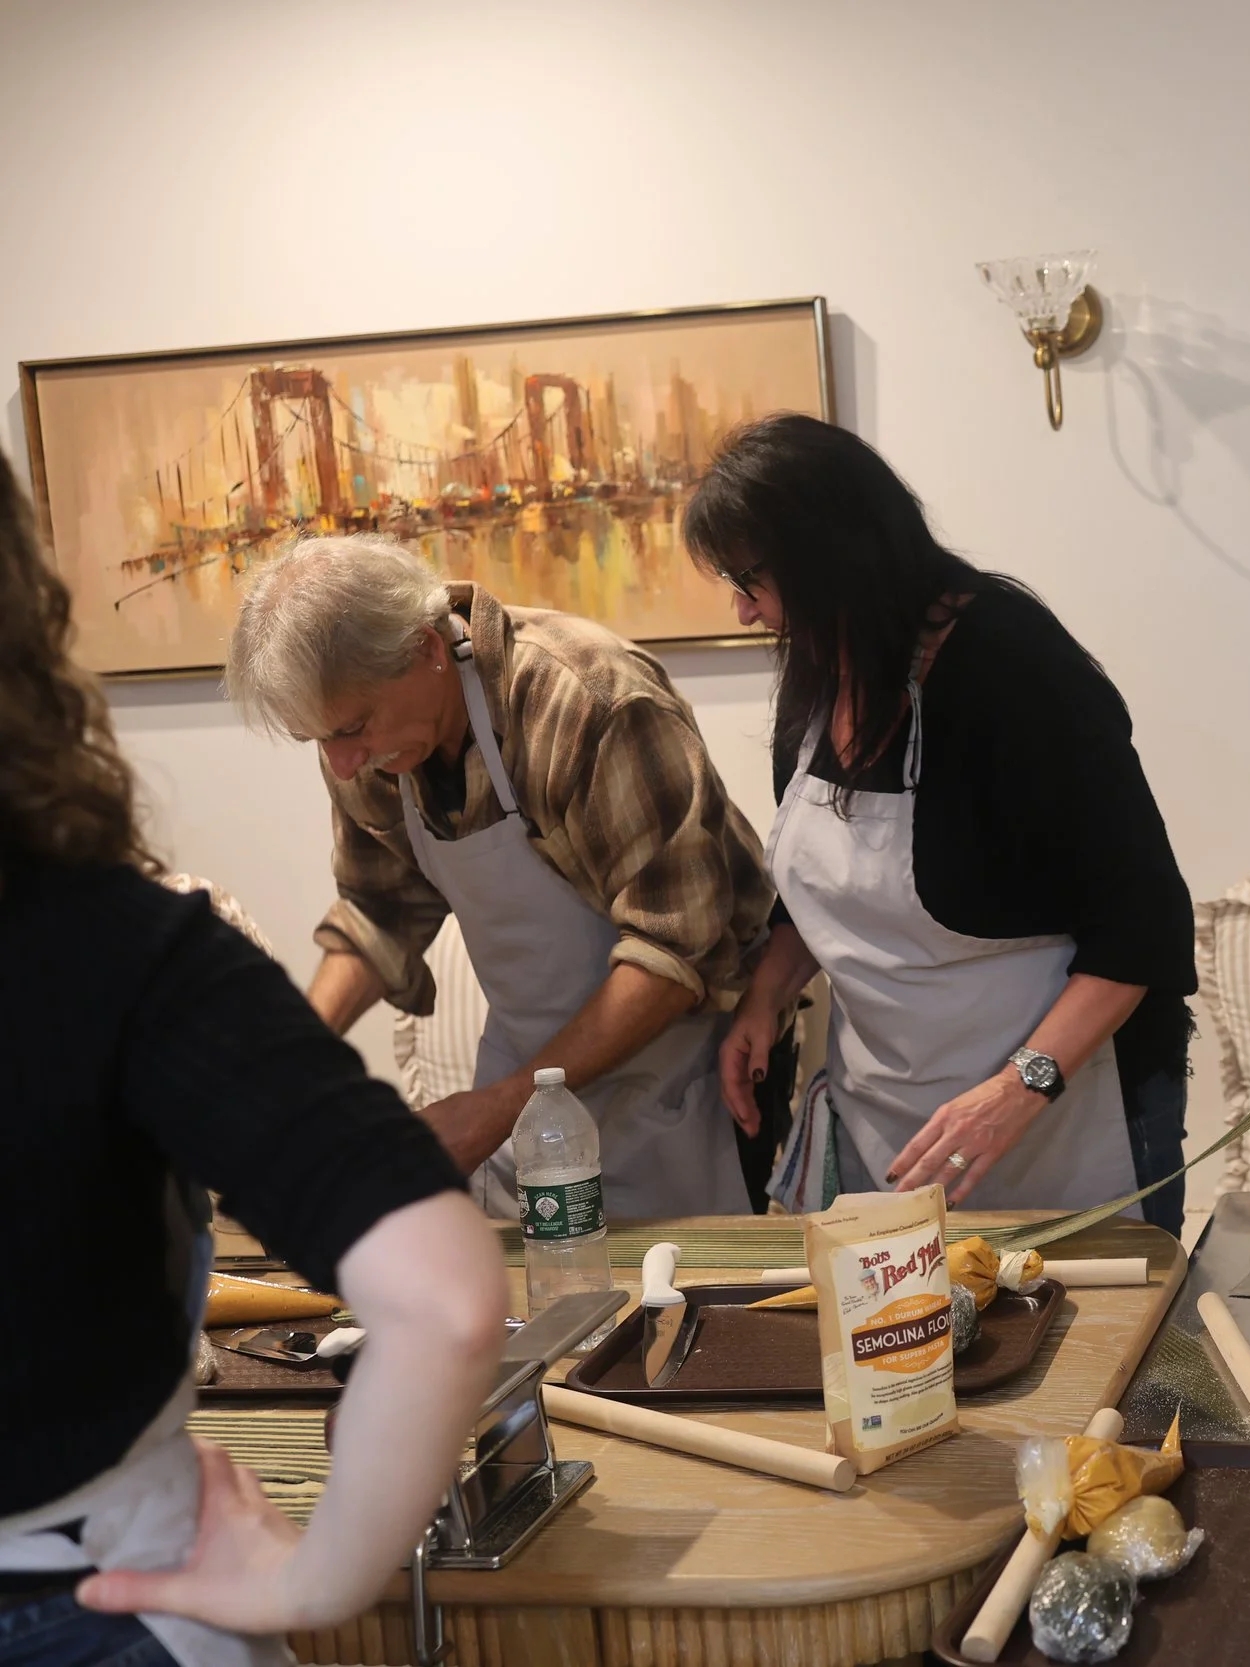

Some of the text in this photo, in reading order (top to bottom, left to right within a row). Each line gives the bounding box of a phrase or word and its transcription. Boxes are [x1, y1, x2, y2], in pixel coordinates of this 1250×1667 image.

[880, 1231, 941, 1296] Red Mill
[895, 1308, 924, 1320] DURUM
[856, 1326, 925, 1354] SEMOLINA
[882, 1355, 897, 1365] FOR
